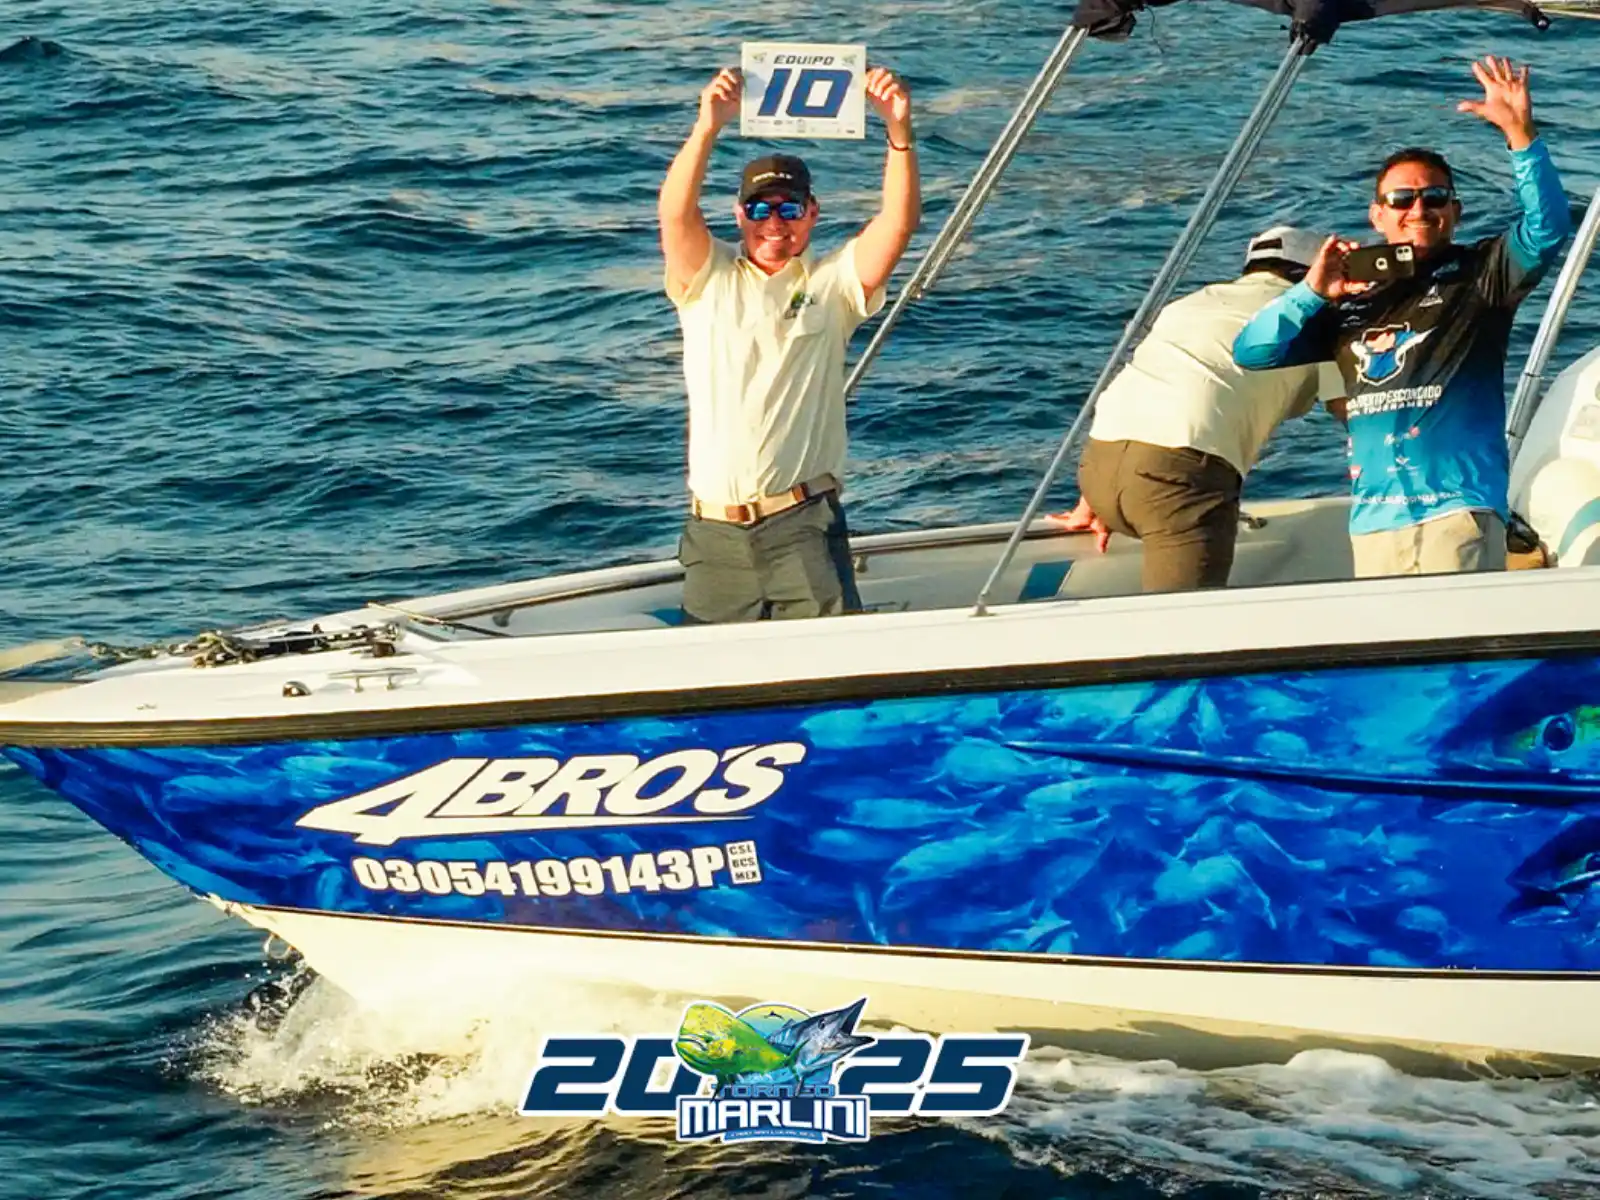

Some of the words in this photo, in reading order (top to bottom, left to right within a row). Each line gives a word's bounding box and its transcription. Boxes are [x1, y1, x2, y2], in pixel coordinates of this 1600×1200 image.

[773, 54, 835, 65] EQUIPO
[757, 68, 853, 118] 10
[352, 848, 724, 898] 03054199143P
